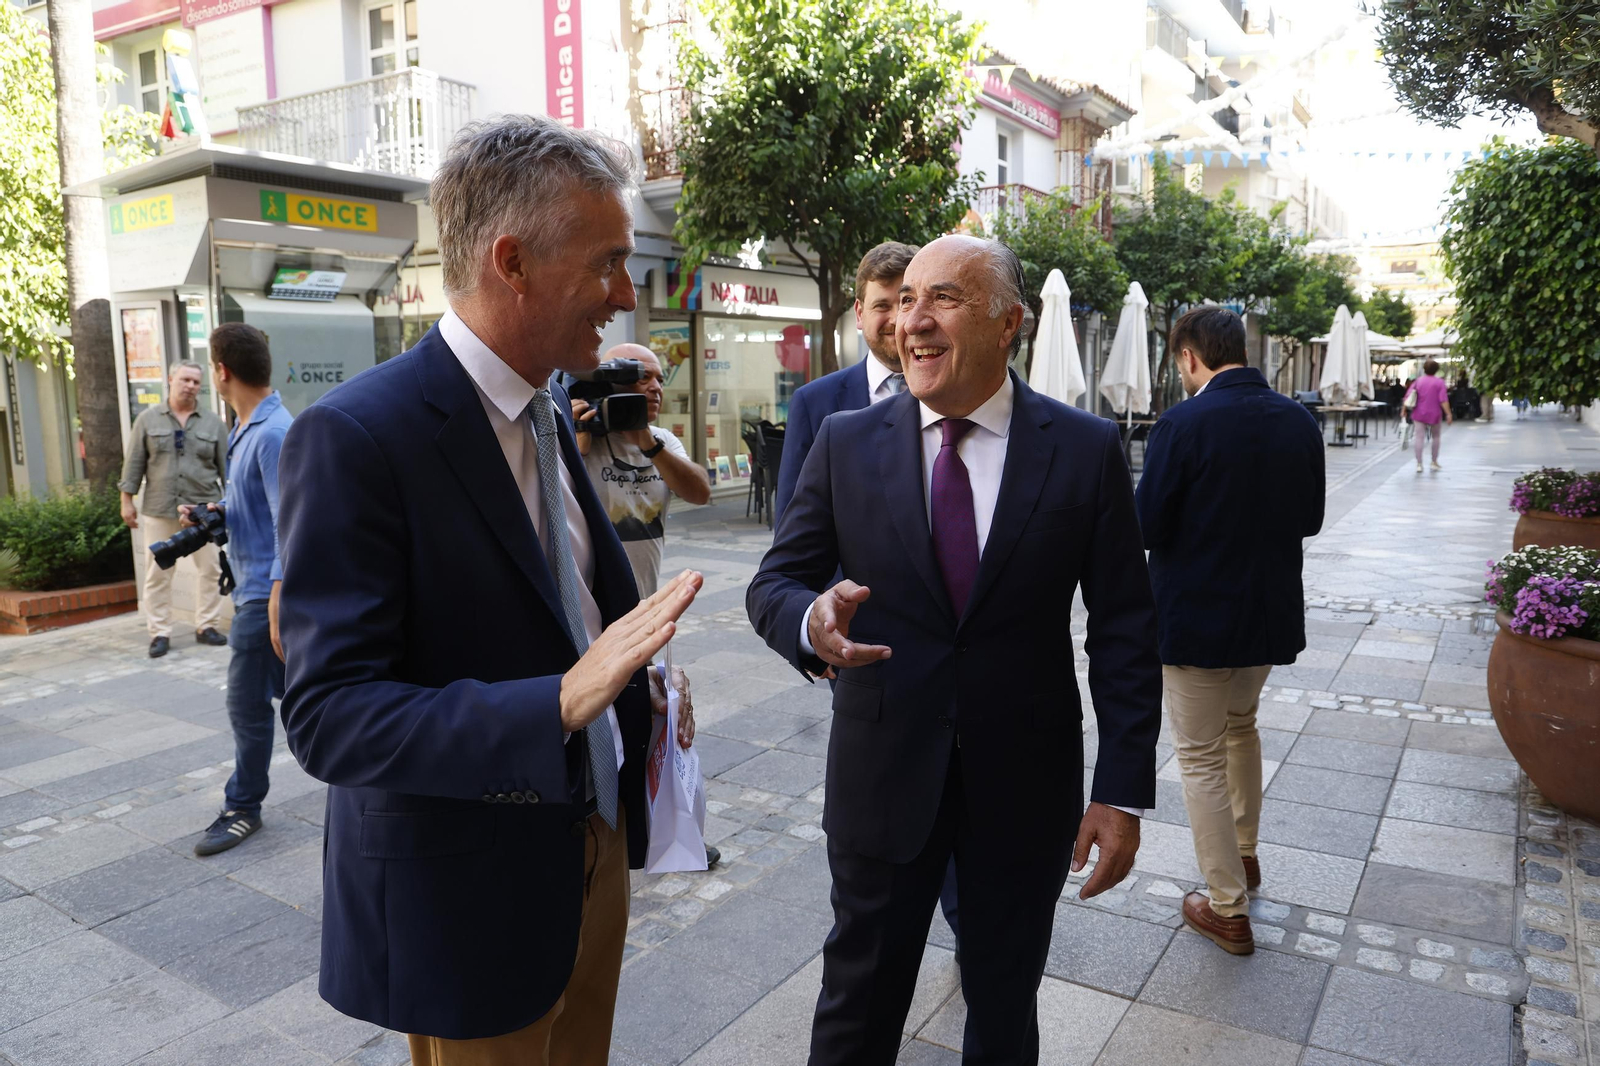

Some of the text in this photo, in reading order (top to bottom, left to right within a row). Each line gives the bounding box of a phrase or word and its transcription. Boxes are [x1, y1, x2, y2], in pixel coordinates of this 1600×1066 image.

[128, 200, 168, 226] ONCE
[297, 200, 369, 226] ONCE
[710, 281, 779, 306] NATALIA
[301, 371, 344, 383] ONCE
